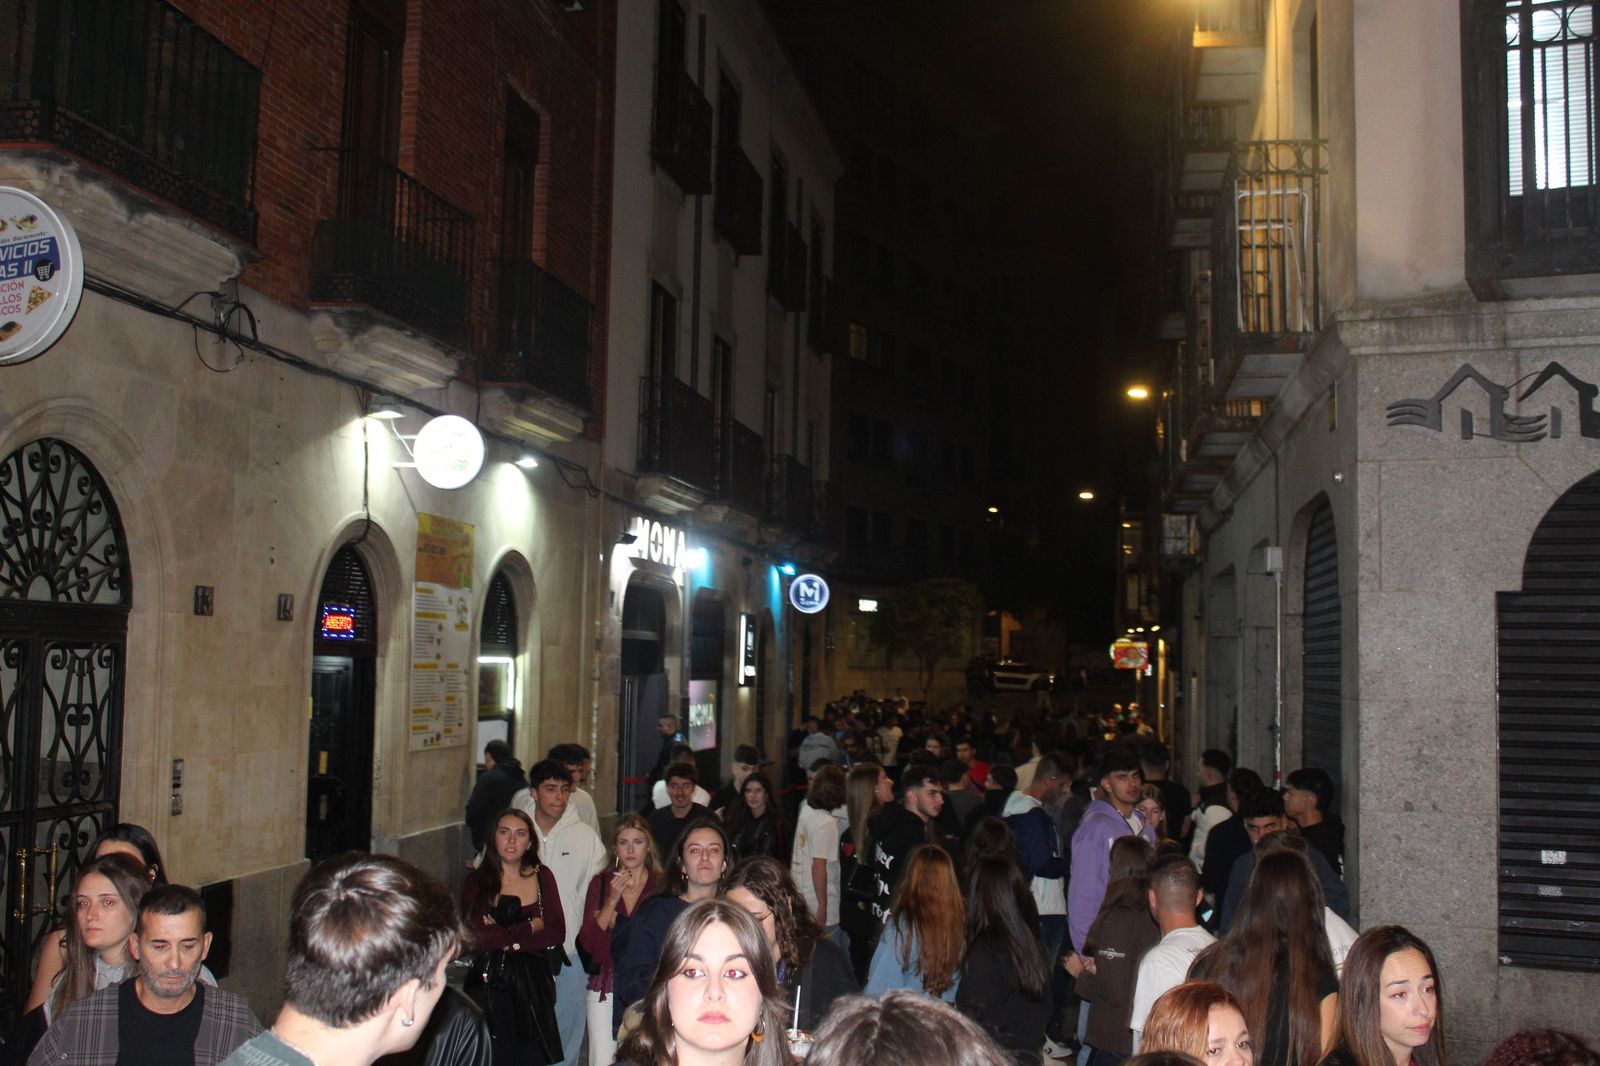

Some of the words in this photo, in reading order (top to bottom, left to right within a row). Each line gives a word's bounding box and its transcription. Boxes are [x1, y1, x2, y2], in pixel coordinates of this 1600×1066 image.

[0, 304, 21, 316] COS
[636, 516, 688, 570] MOMA
[799, 581, 820, 603] M
